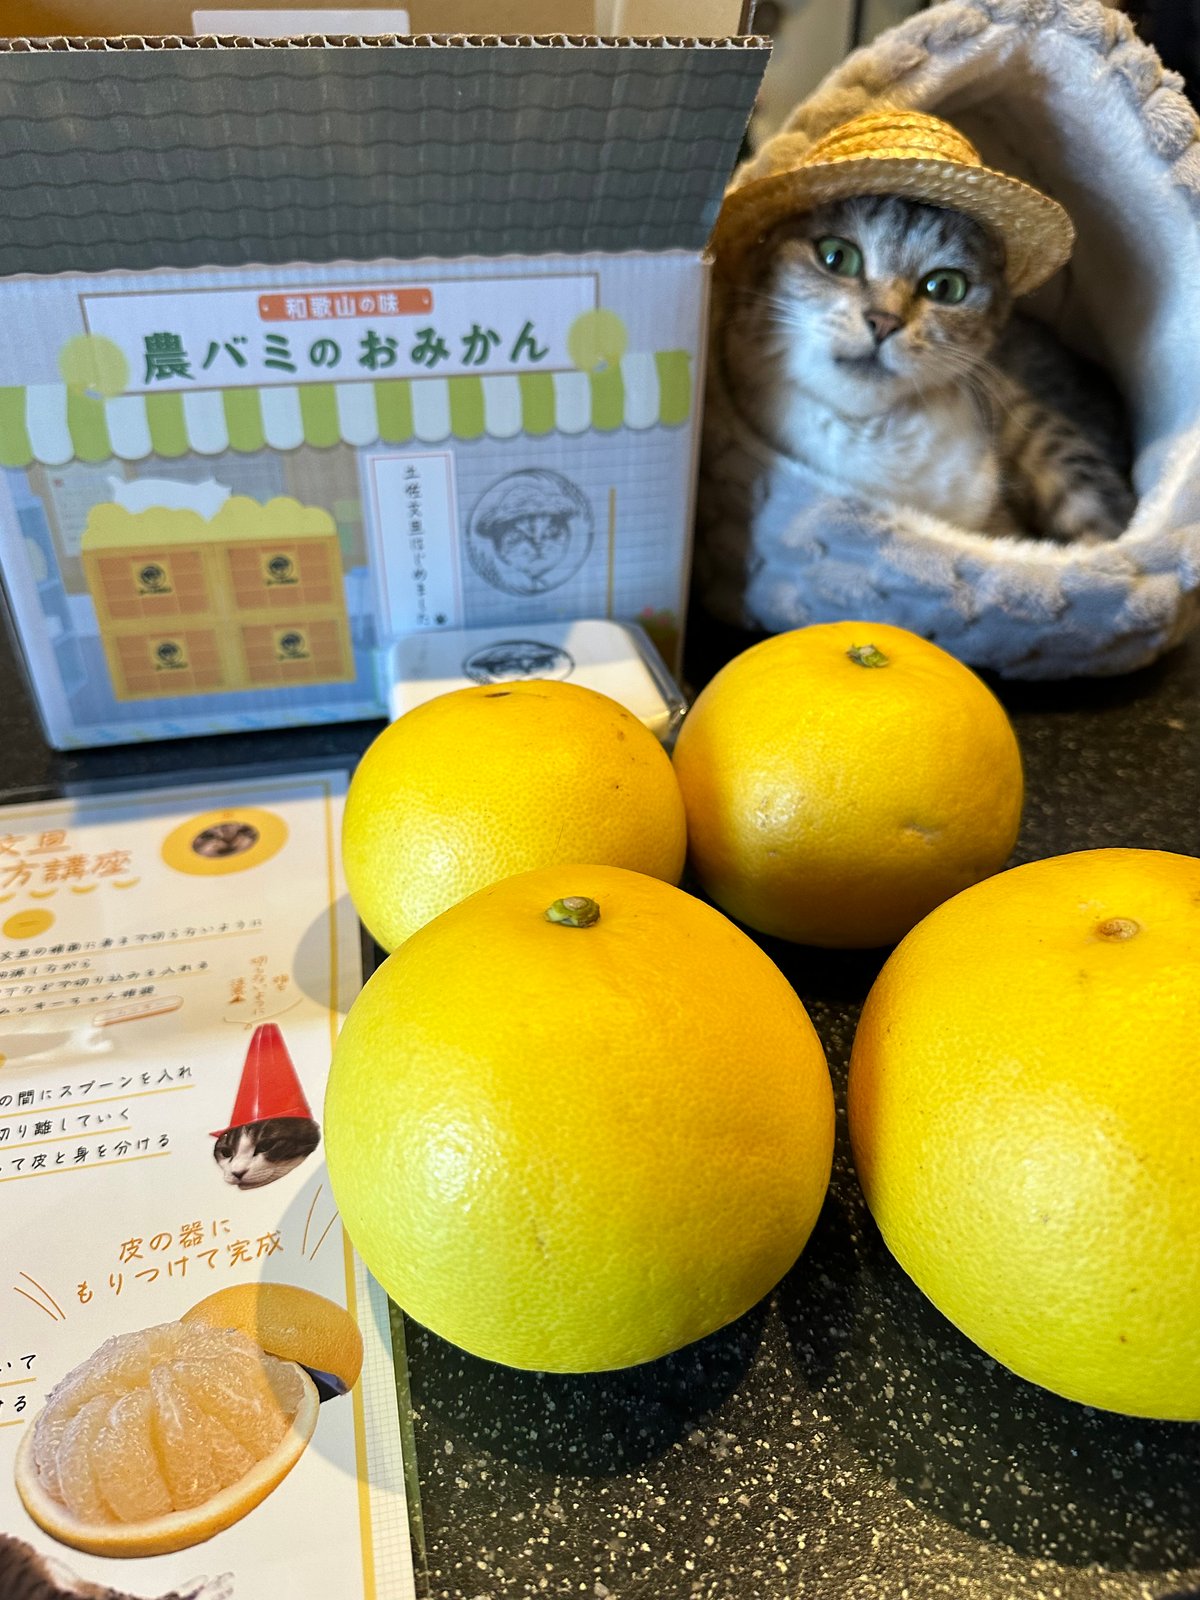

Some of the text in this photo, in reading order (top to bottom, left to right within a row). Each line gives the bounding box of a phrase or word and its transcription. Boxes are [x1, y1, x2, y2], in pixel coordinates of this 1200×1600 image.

[285, 293, 400, 320] 和歌山の味
[144, 319, 550, 386] 農バミのおみかん
[0, 960, 208, 997] フなどで切り込みを入れる
[0, 1066, 192, 1106] の間にスプーンを入れ
[0, 1133, 170, 1171] て皮と身を分ける
[119, 1219, 231, 1263] 皮の器に
[77, 1230, 284, 1304] もりつけて完成
[0, 1395, 26, 1413] る
